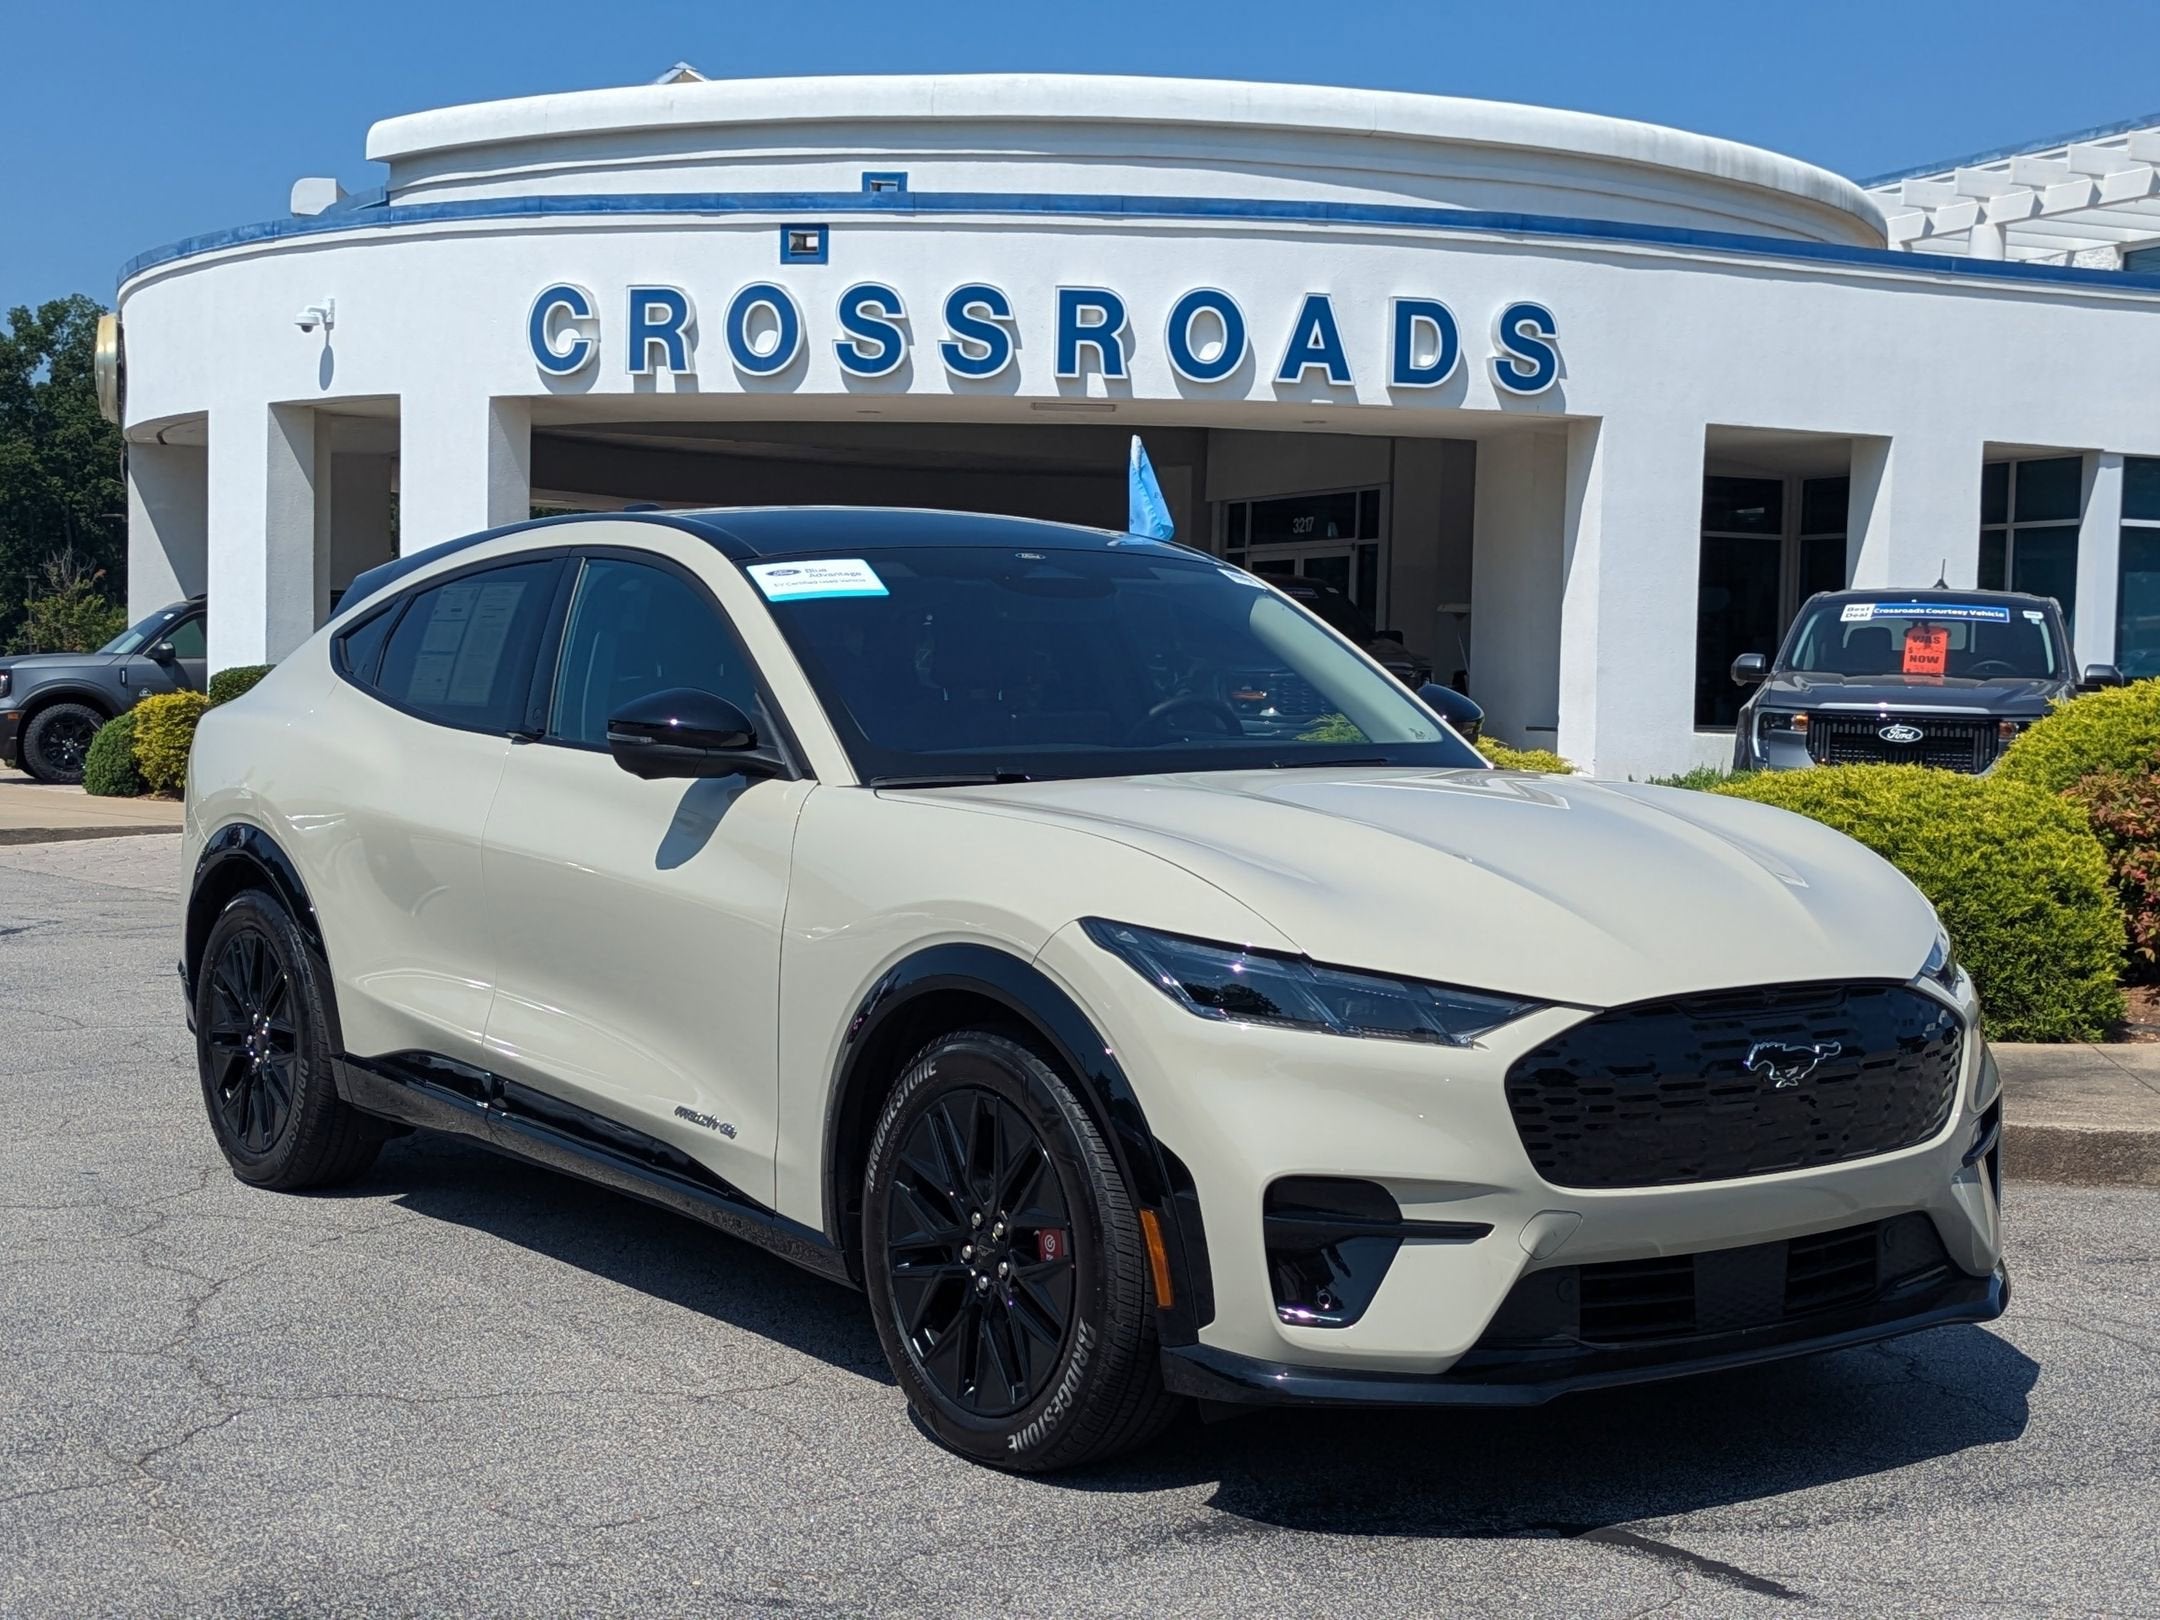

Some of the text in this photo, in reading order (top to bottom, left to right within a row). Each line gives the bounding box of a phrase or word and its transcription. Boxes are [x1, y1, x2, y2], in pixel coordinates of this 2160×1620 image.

[527, 281, 1560, 396] CROSSROADS
[1292, 516, 1314, 534] 3217
[1925, 608, 1968, 616] Courtesy
[1969, 609, 2005, 618] Vehicle
[1909, 655, 1940, 664] NOW
[1886, 728, 1915, 740] Ford
[1007, 1316, 1097, 1453] BRIDGESTONE
